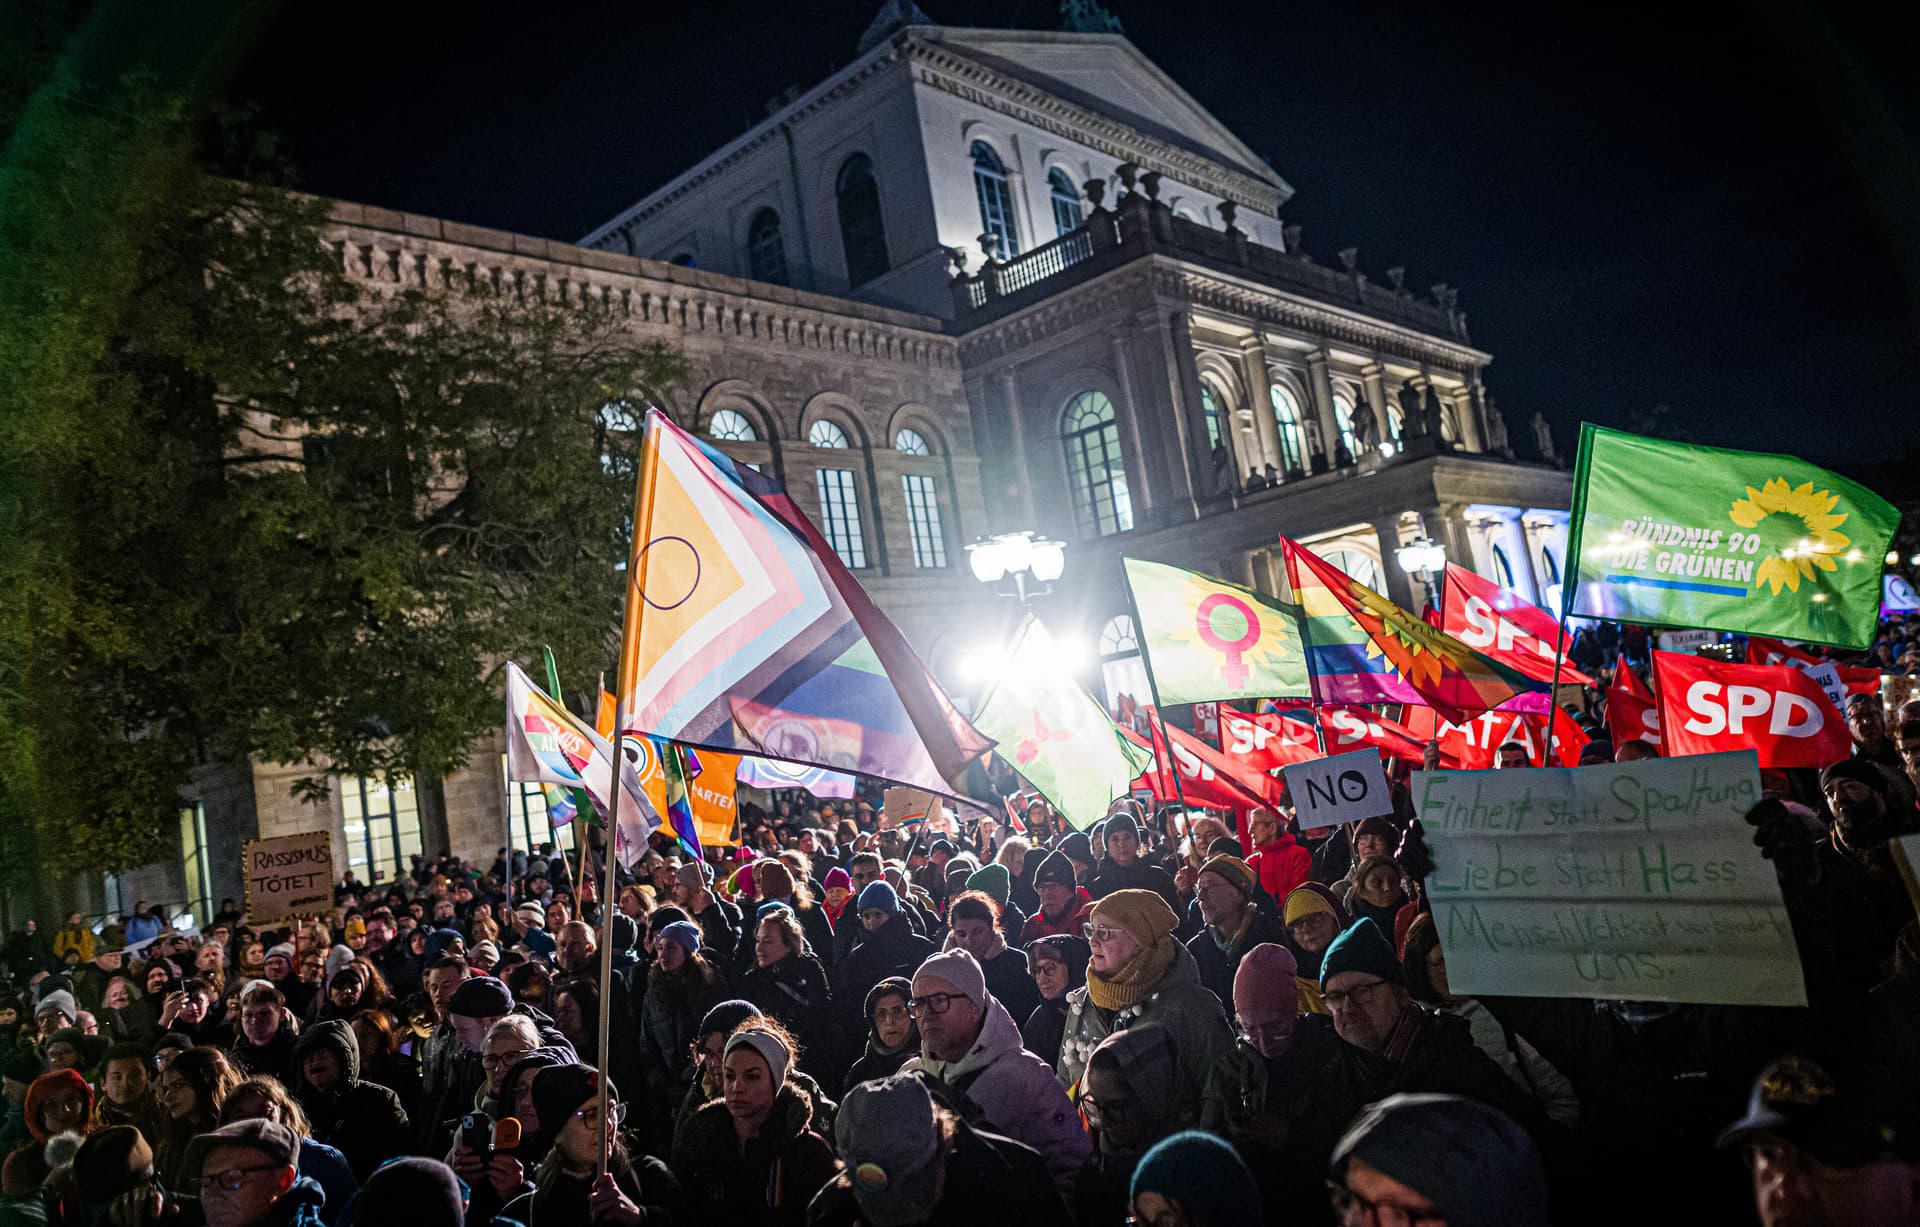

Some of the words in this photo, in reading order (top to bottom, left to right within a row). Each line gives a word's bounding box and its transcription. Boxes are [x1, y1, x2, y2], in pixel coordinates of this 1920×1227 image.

[1621, 515, 1723, 550] BÜNDNIS
[1727, 531, 1761, 555] 90
[1611, 547, 1650, 571] DIE
[1655, 549, 1754, 583] GRÜNEN
[1684, 680, 1824, 738] SPD
[1230, 713, 1315, 755] SPD
[1306, 769, 1368, 810] NO
[1421, 775, 1533, 832] Einheit
[1610, 766, 1756, 833] Spaltung
[253, 845, 329, 870] RASSISMUS
[1431, 842, 1540, 893] Liebe
[1638, 843, 1738, 894] Hass
[251, 872, 323, 893] TÖTET
[1448, 902, 1670, 954] Menschlichkeit
